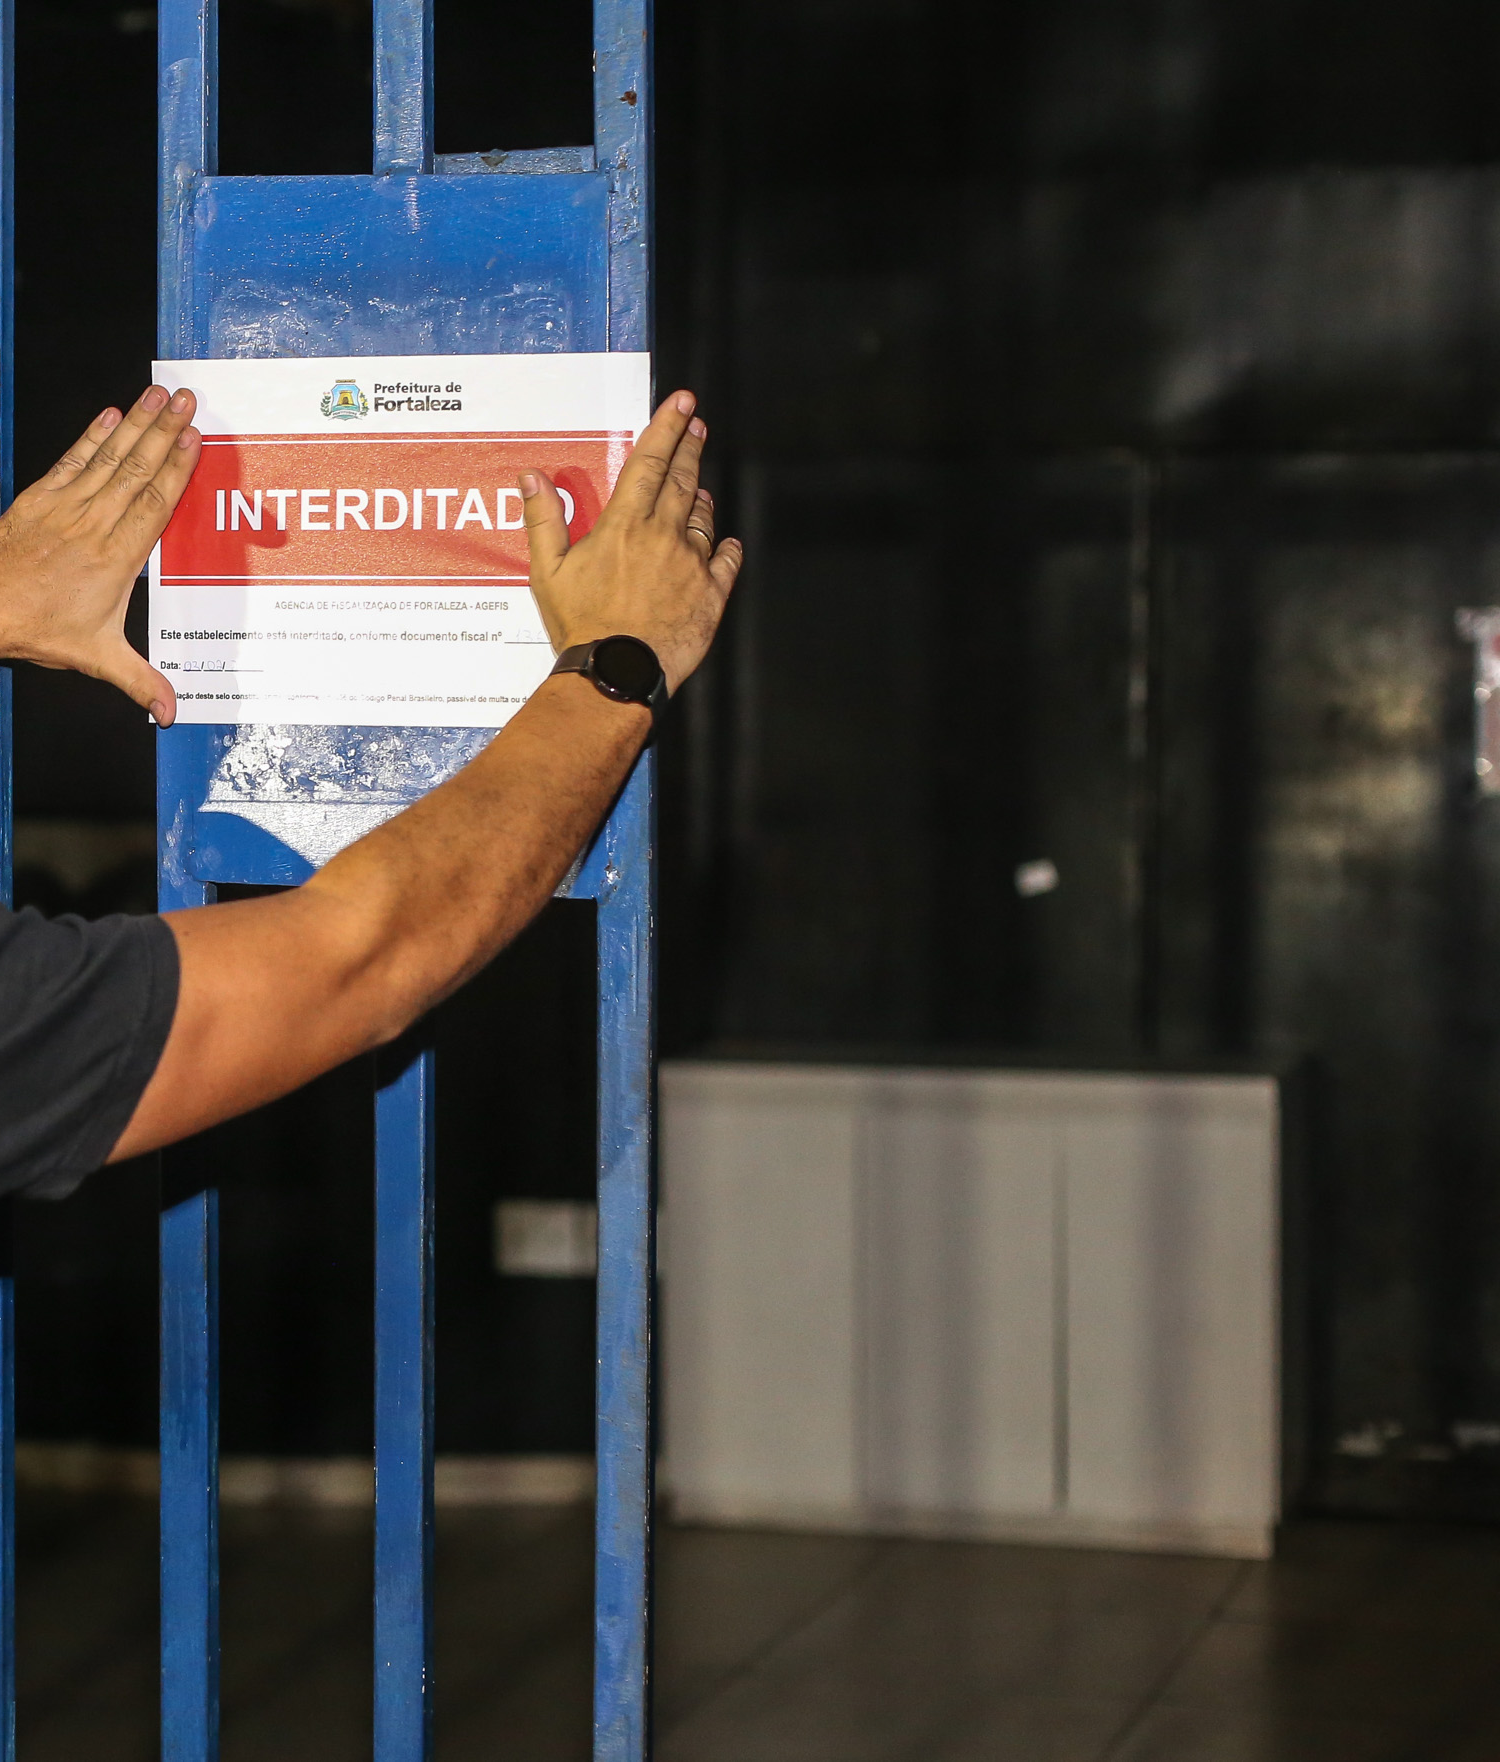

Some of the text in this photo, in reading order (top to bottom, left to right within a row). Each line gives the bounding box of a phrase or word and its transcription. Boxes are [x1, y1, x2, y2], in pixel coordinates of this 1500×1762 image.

[373, 382, 462, 394] Prefeitura de
[373, 396, 462, 412] Fortaleza
[317, 601, 329, 610] DE
[399, 601, 411, 610] DE
[414, 601, 467, 611] FORTALEZA
[475, 601, 509, 611] AGEFIS
[160, 629, 181, 640] Este
[184, 629, 263, 641] estabelecimento
[266, 631, 287, 641] está
[349, 631, 398, 641] conforme
[400, 631, 458, 642] documento
[461, 631, 488, 642] fiscal
[160, 660, 181, 670] Data:
[195, 692, 214, 700] deste
[215, 692, 231, 700] selo
[387, 694, 407, 702] Penal
[478, 695, 487, 703] de
